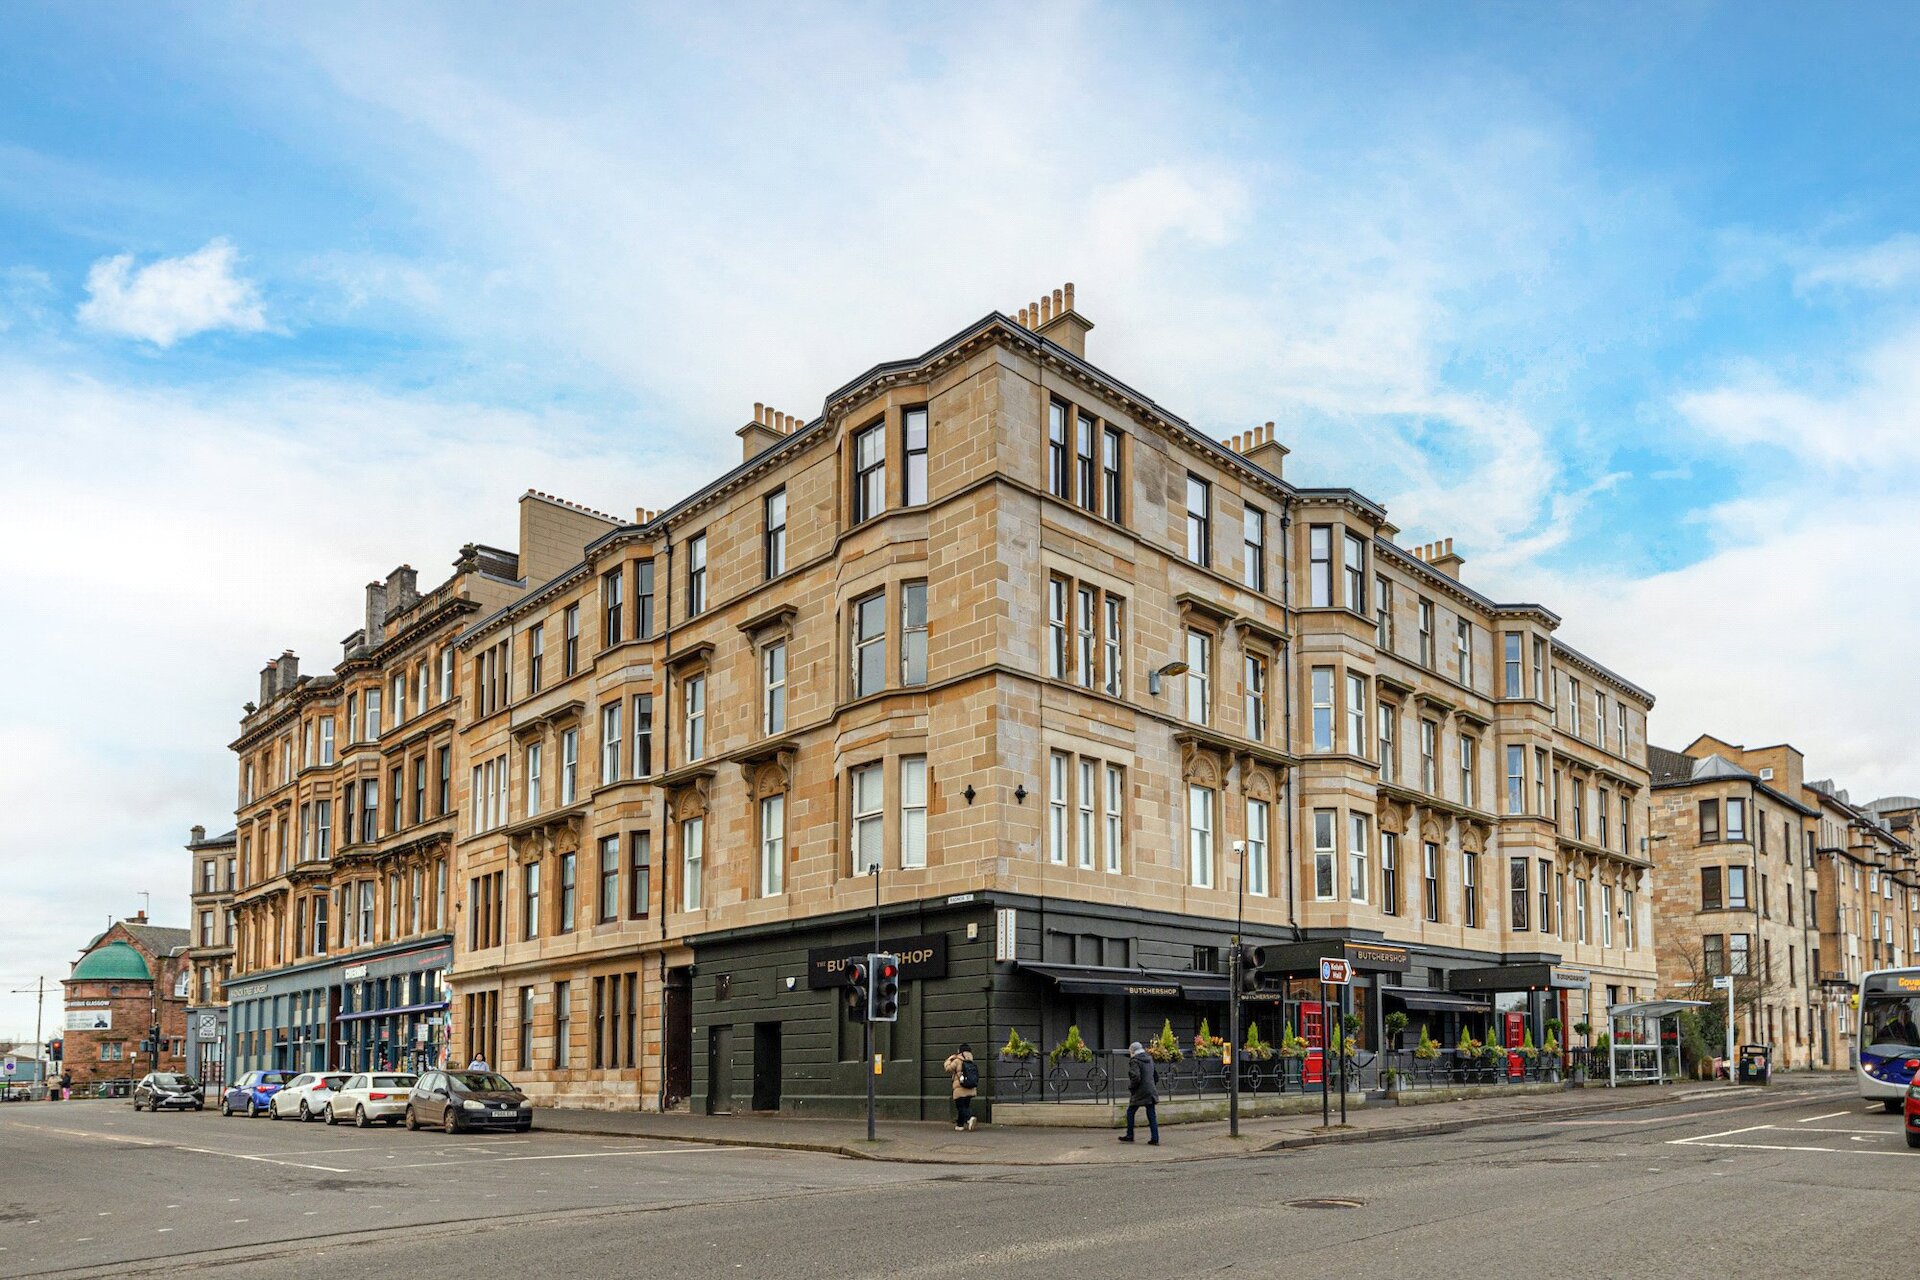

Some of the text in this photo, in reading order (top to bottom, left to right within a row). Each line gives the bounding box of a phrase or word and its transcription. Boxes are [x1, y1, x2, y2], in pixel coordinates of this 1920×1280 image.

[1357, 950, 1407, 963] BUTCHERSHOP
[1330, 963, 1344, 971] Kelvin
[1332, 971, 1342, 979] Hall
[1129, 987, 1177, 995] BUTCHERSHOP
